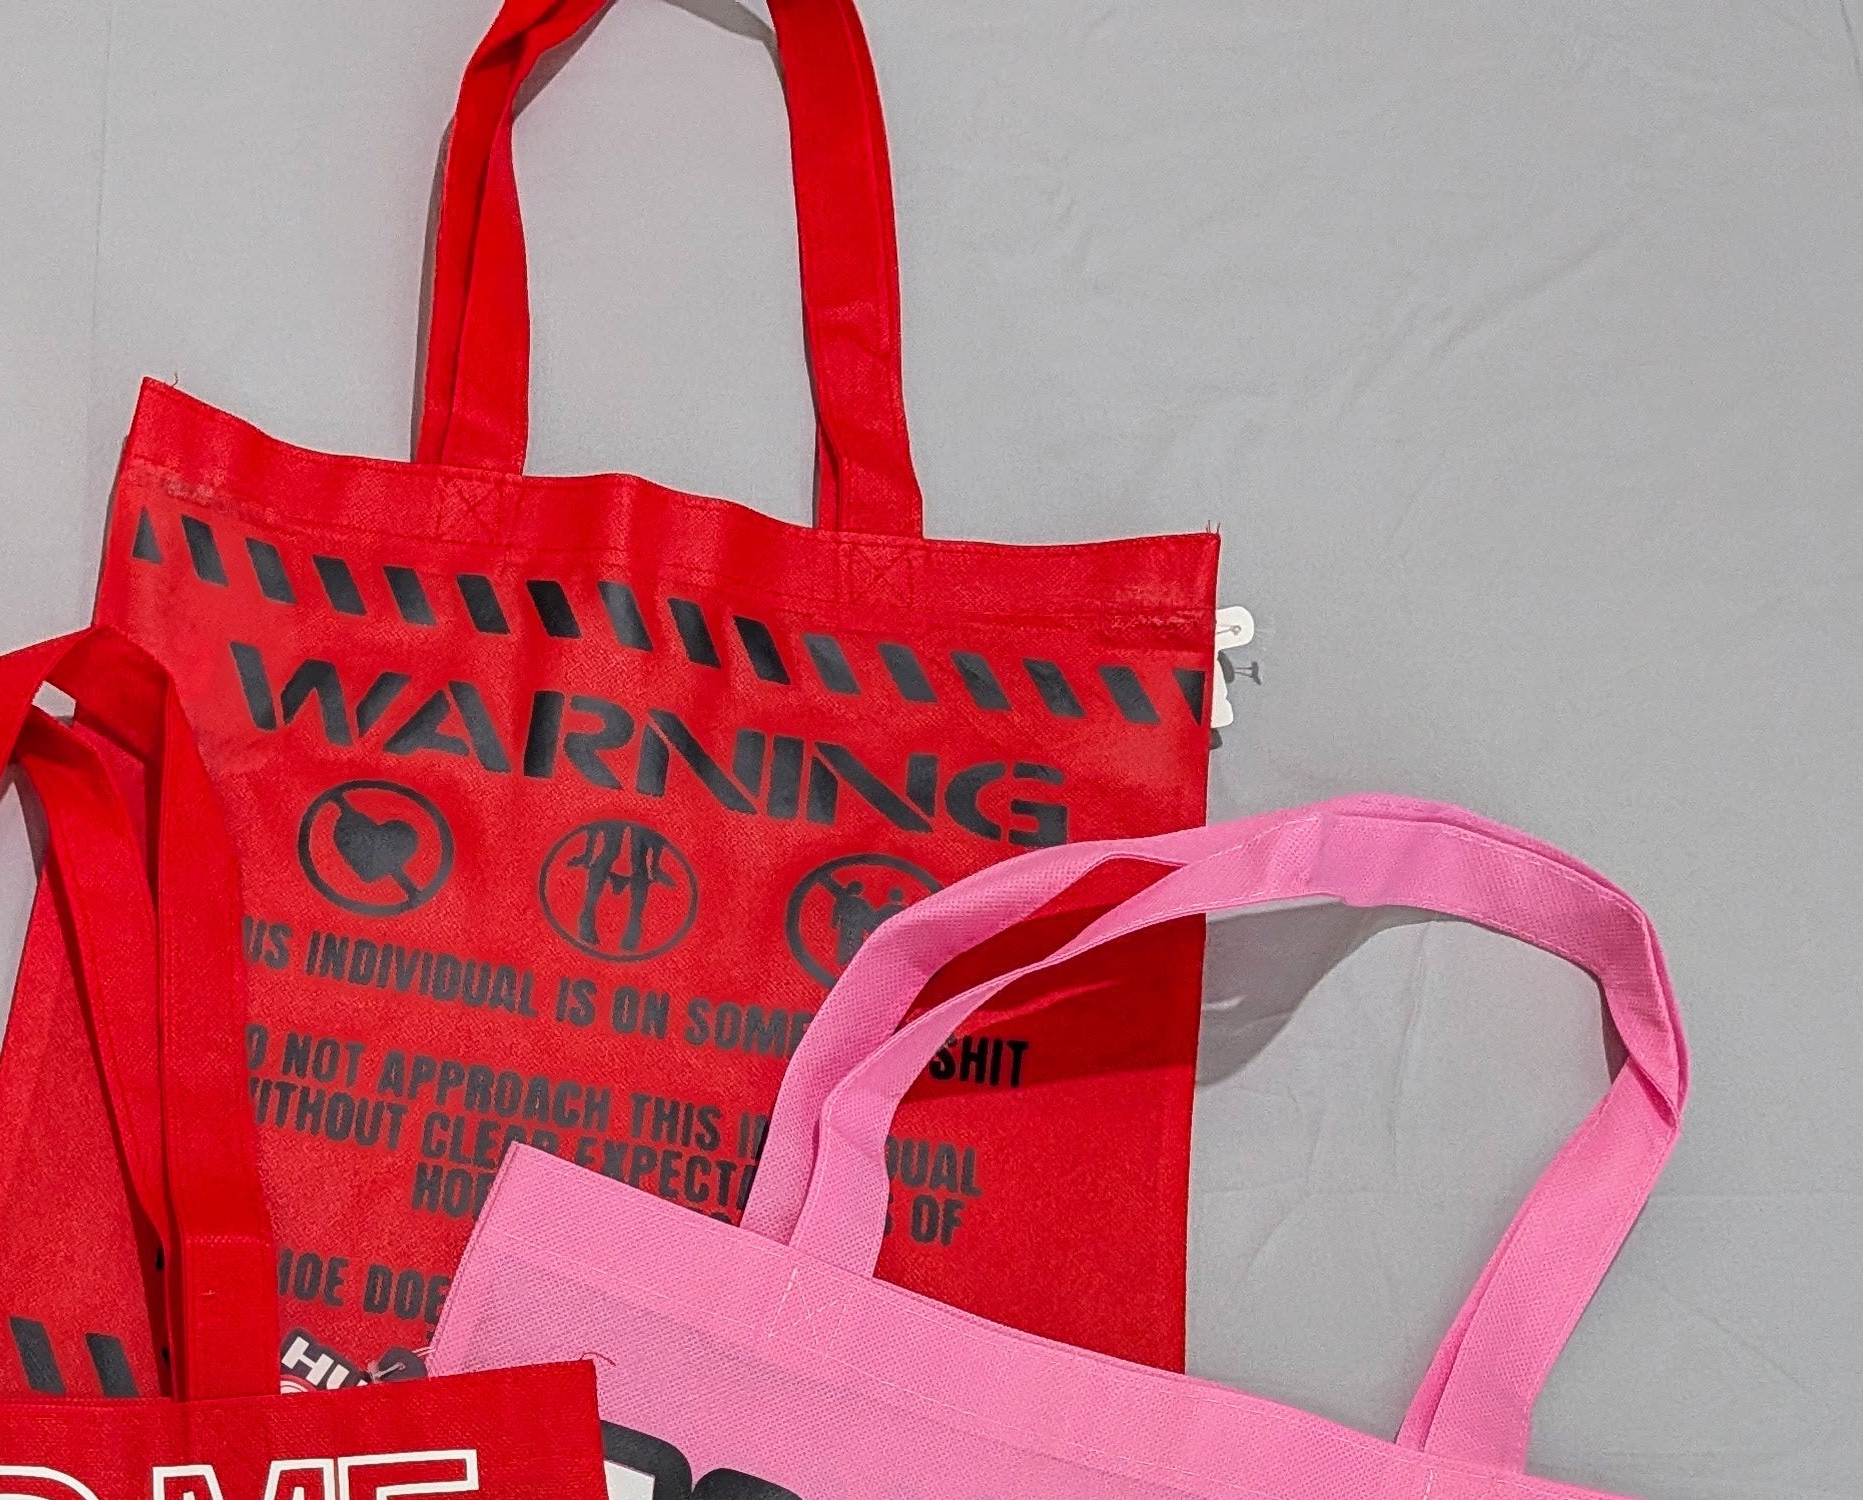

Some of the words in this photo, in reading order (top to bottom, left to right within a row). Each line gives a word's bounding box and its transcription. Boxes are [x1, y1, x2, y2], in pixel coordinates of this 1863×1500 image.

[229, 640, 1068, 847] WARNING
[306, 930, 537, 1018] INDIVIDUAL
[557, 977, 597, 1028] IS
[611, 986, 671, 1039] ON
[249, 1076, 408, 1151] ITHOUT
[911, 1194, 966, 1246] OF
[282, 1031, 366, 1088] NOT
[377, 1050, 611, 1133] APPROACH
[630, 1091, 723, 1152] THIS
